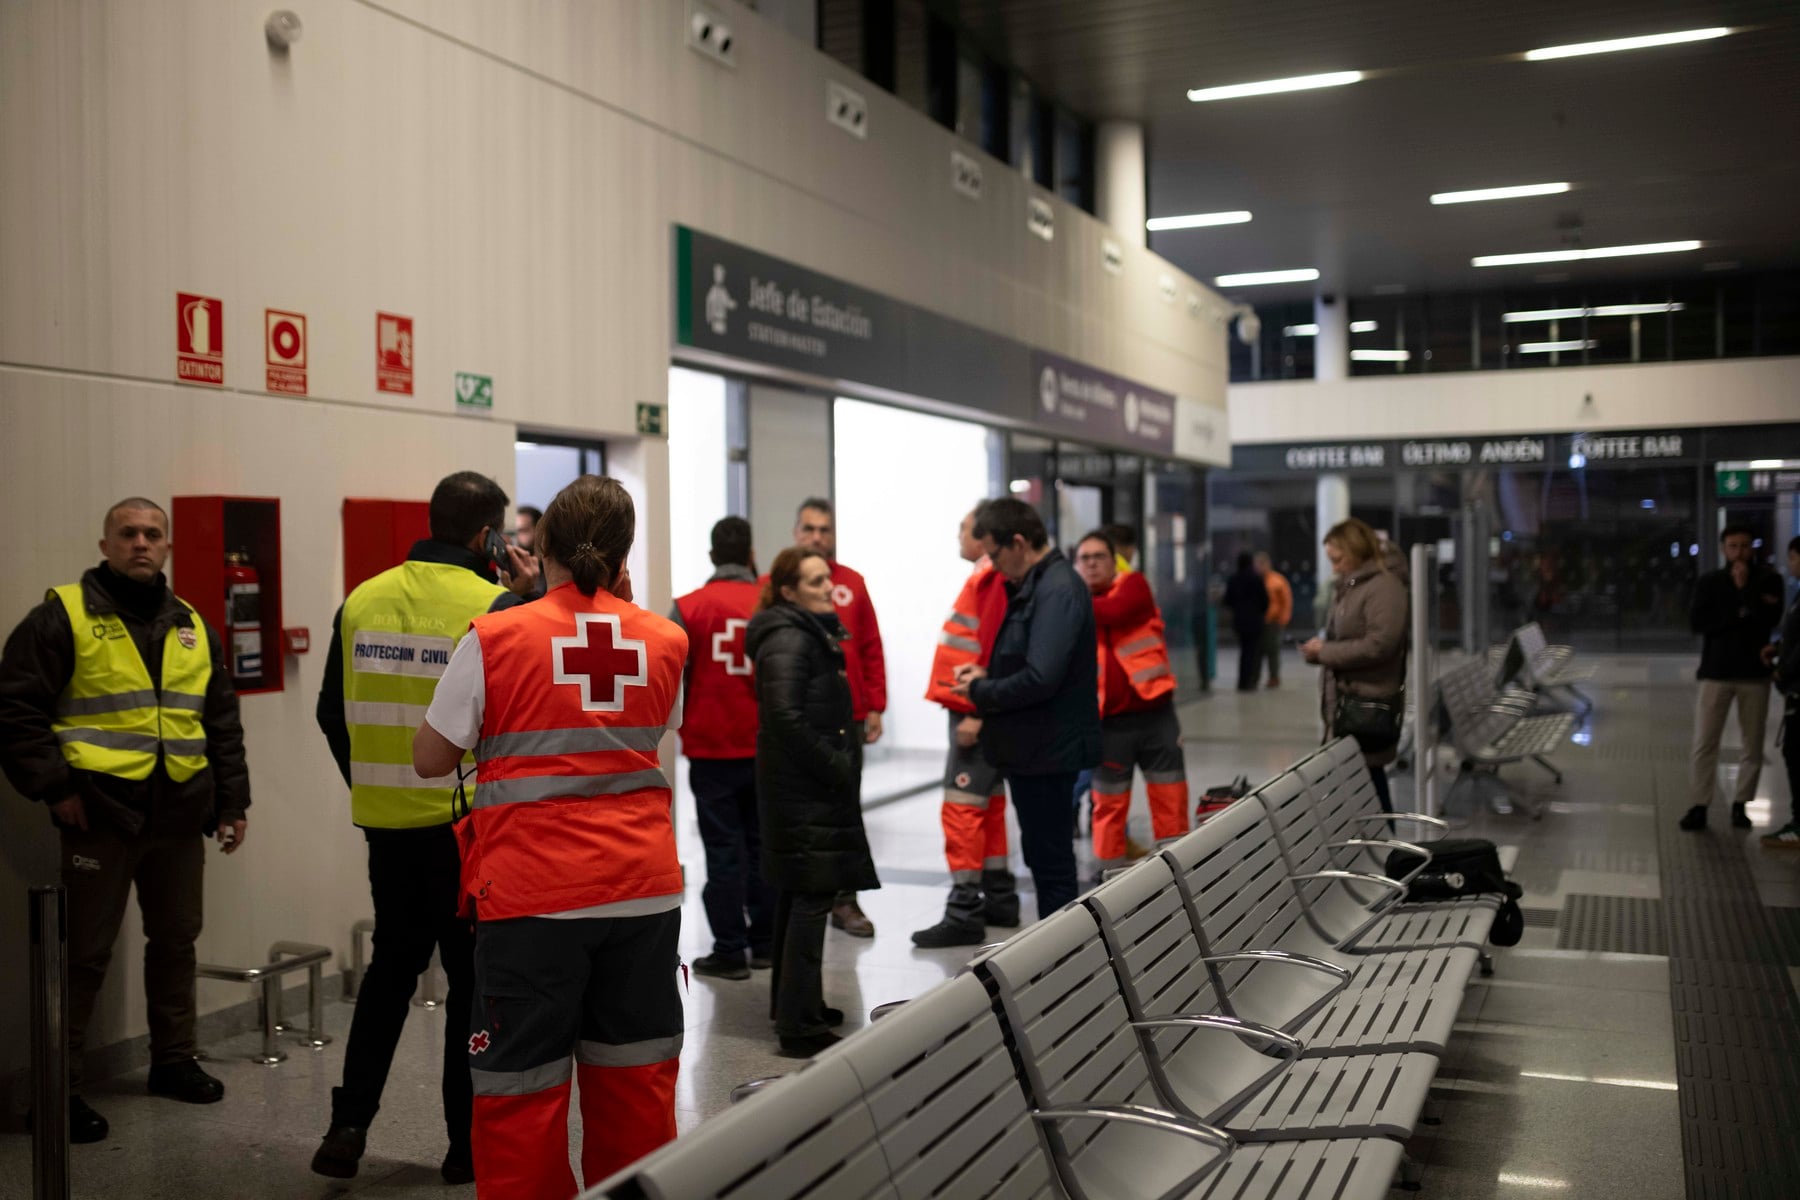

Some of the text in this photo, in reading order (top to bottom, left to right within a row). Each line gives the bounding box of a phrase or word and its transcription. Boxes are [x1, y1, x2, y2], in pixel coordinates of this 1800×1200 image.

[748, 276, 871, 338] Jefe de Estación
[180, 360, 221, 380] EXTINTOR
[1286, 445, 1384, 470] COFFEE BAR
[1403, 438, 1544, 465] ÚLTIMO ANDÉN
[1571, 434, 1682, 460] COFFEE BAR
[421, 648, 449, 665] CIVIL
